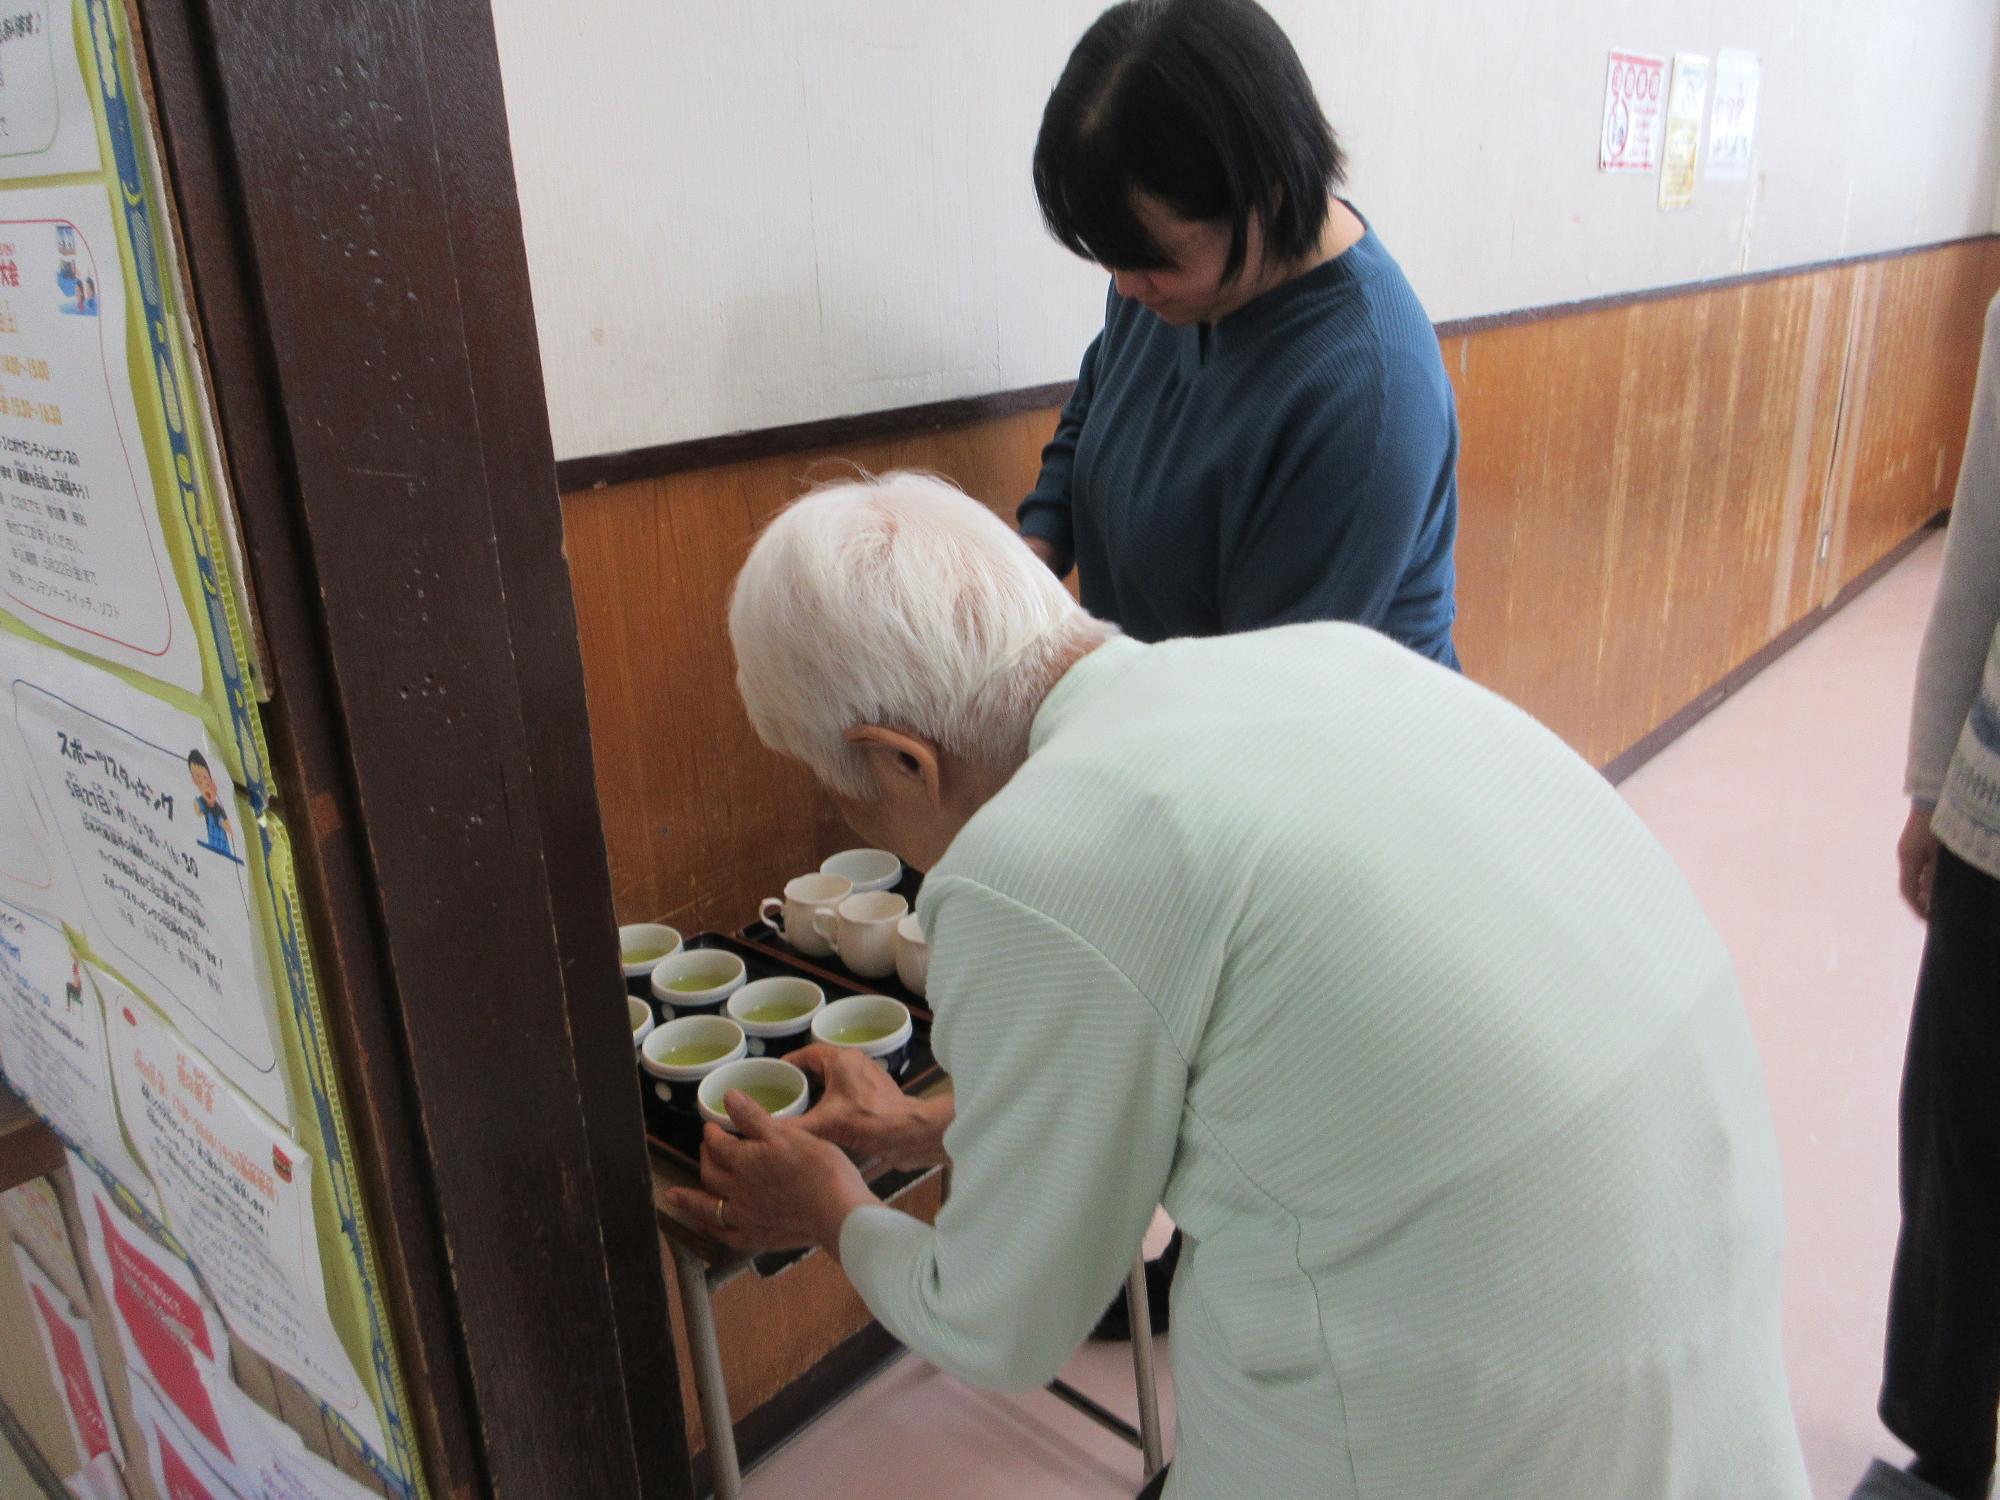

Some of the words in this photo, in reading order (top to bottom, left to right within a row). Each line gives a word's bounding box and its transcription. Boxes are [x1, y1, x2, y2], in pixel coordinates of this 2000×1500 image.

[57, 731, 174, 822] スポーツスタッキング
